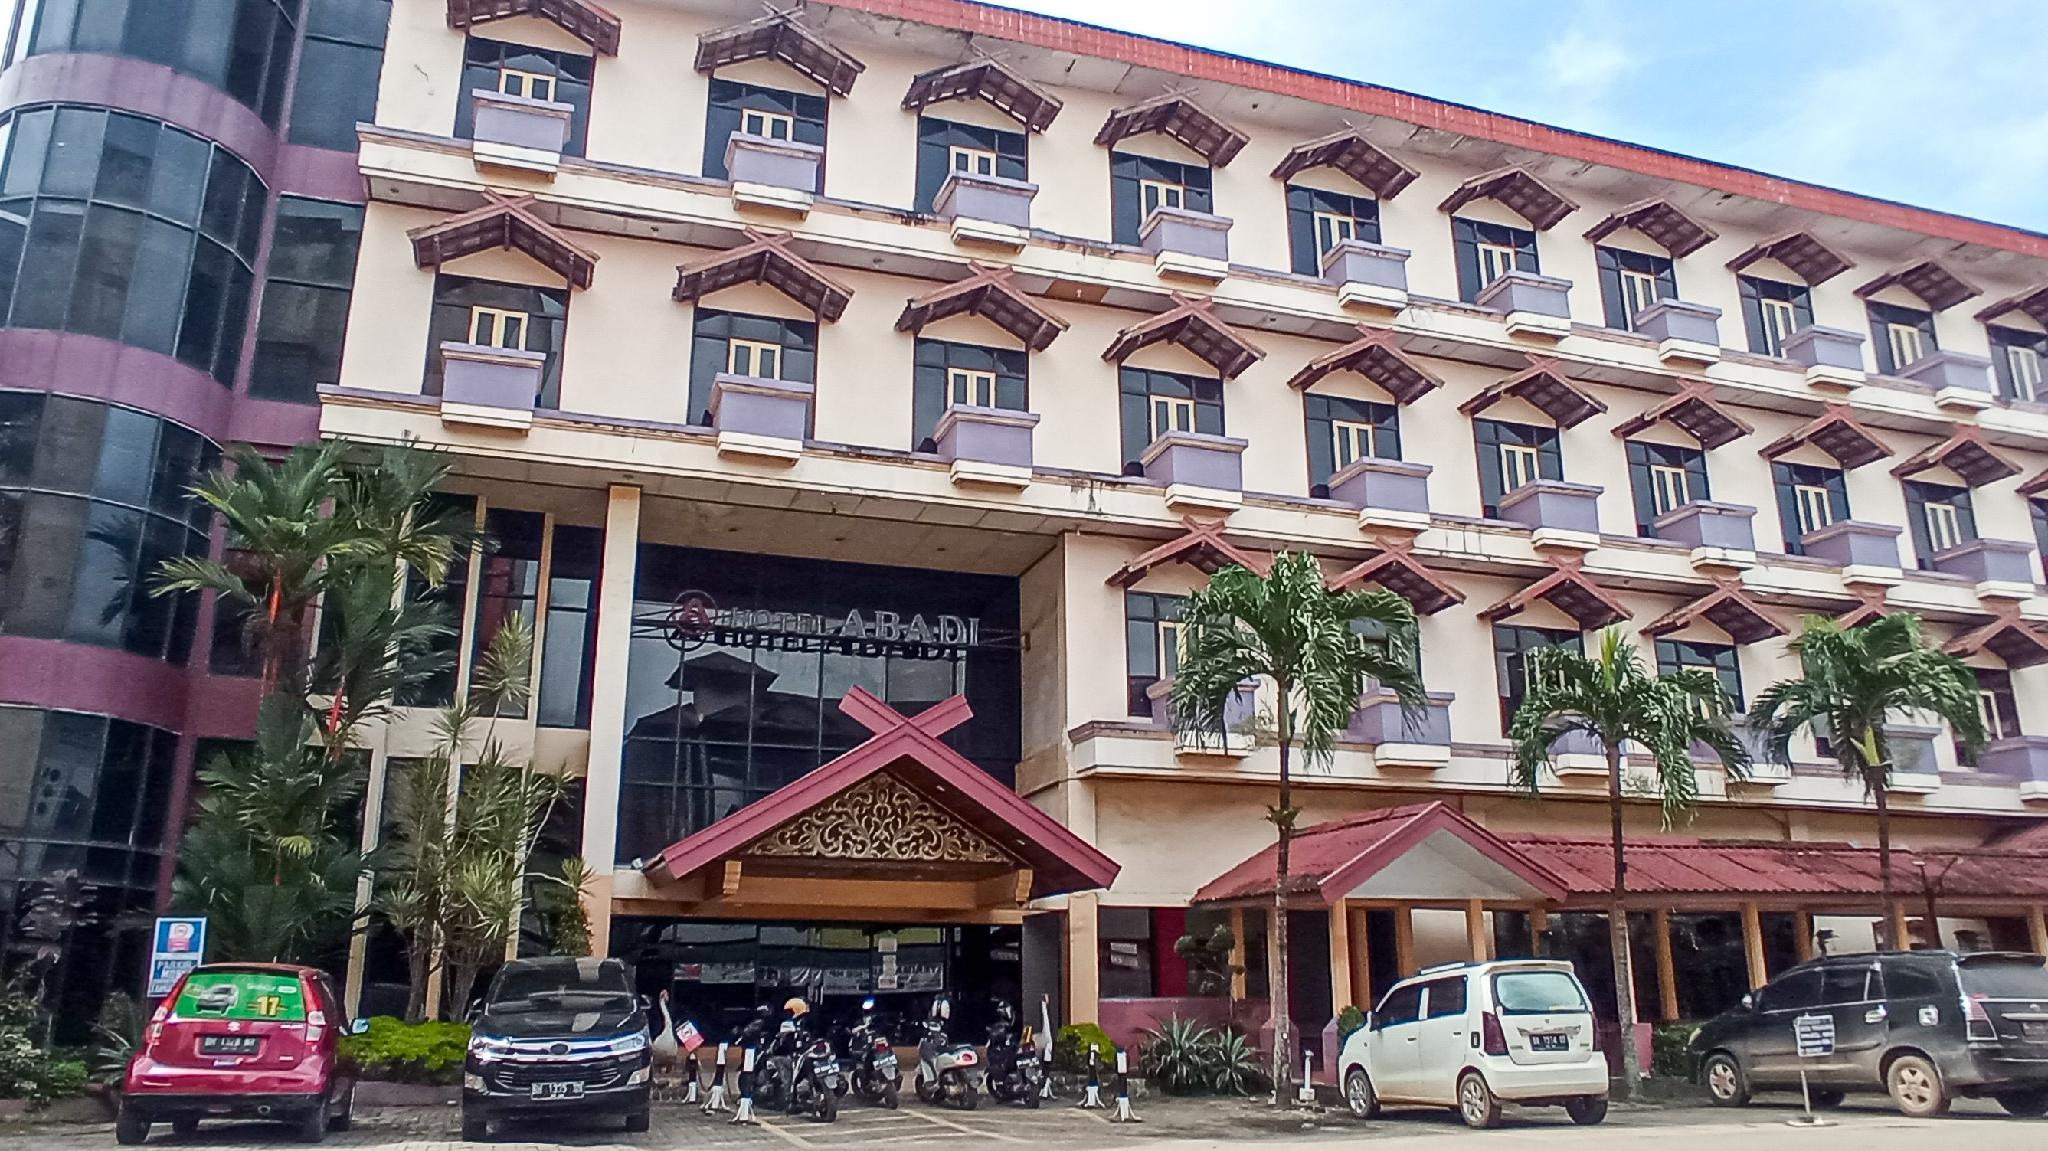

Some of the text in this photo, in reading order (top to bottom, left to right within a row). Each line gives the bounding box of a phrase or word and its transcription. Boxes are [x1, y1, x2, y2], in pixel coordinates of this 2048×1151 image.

[731, 607, 980, 646] HOTEL ABADI
[256, 996, 281, 1017] 17
